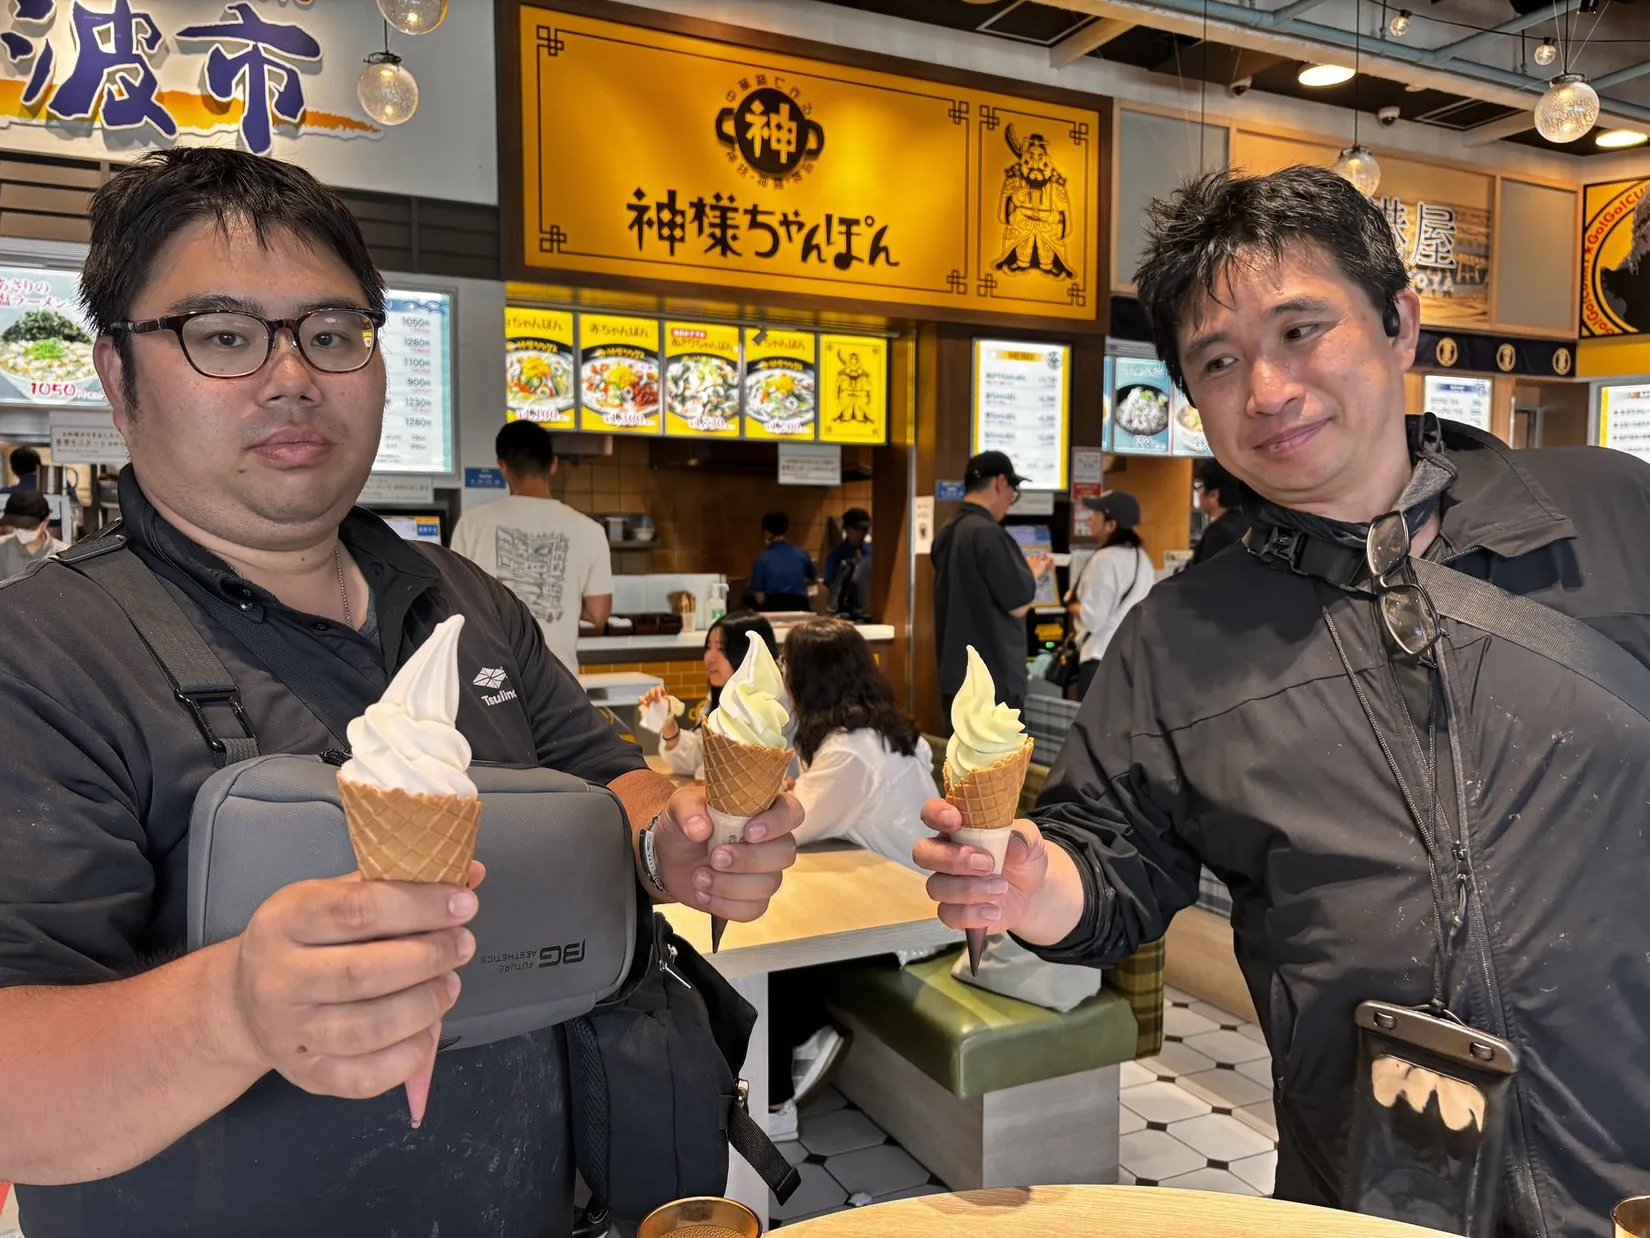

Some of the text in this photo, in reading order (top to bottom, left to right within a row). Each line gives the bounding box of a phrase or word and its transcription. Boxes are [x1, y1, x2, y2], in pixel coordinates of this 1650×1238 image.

[744, 99, 798, 165] 神
[626, 186, 900, 271] 神様ちゃんぽん
[480, 950, 537, 964] AESTHETICS
[499, 961, 534, 973] FUTURE
